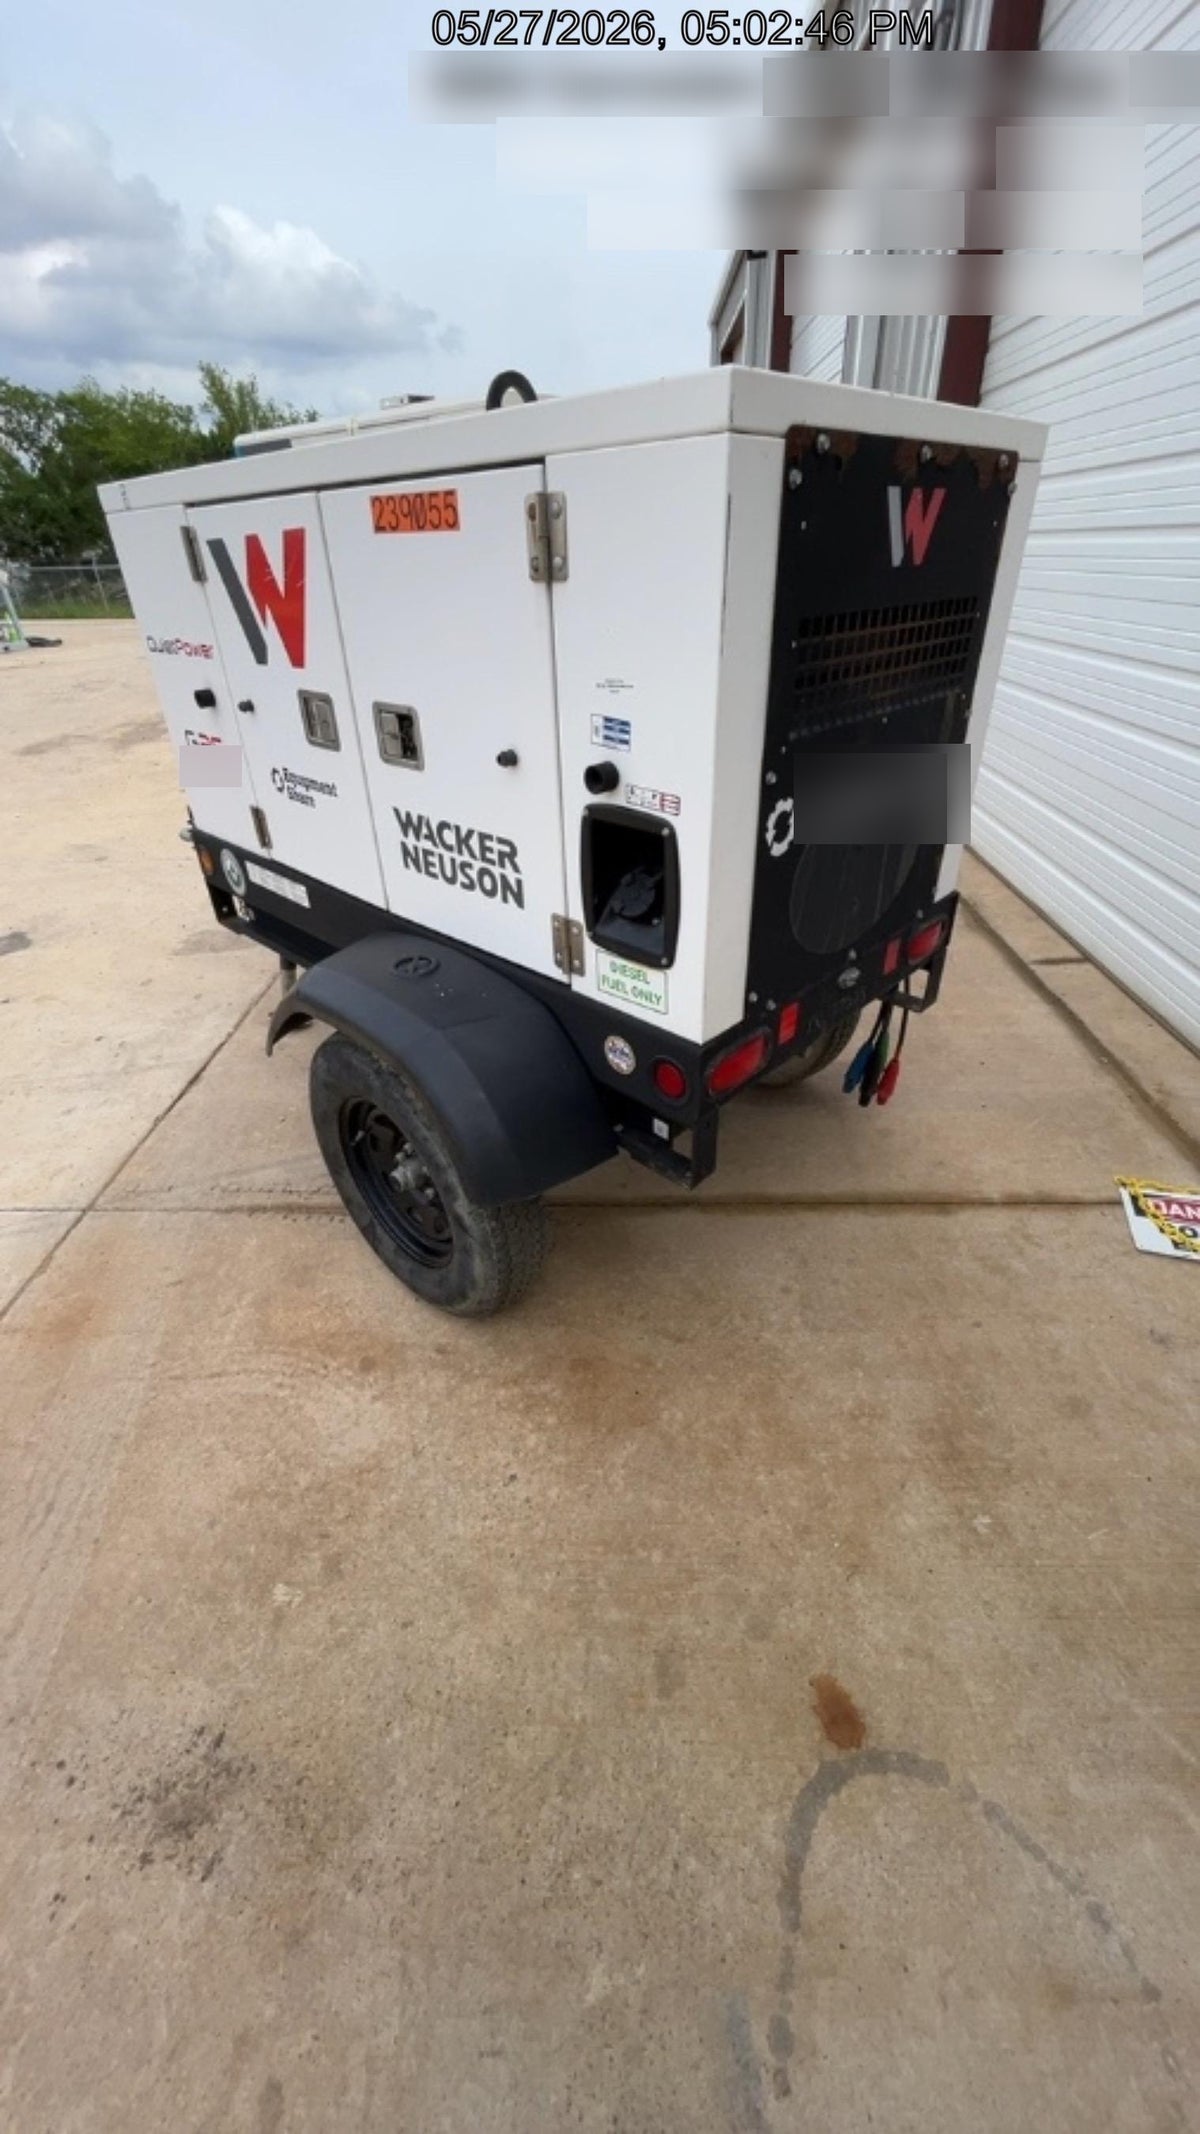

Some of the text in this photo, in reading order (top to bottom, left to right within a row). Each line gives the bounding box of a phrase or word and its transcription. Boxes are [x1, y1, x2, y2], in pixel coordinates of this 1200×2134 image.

[371, 489, 458, 531] 239055
[392, 806, 522, 875] WACKER
[400, 840, 525, 910] NEUSON
[601, 974, 663, 1006] FUEL ONLY
[609, 961, 650, 984] DIESEL
